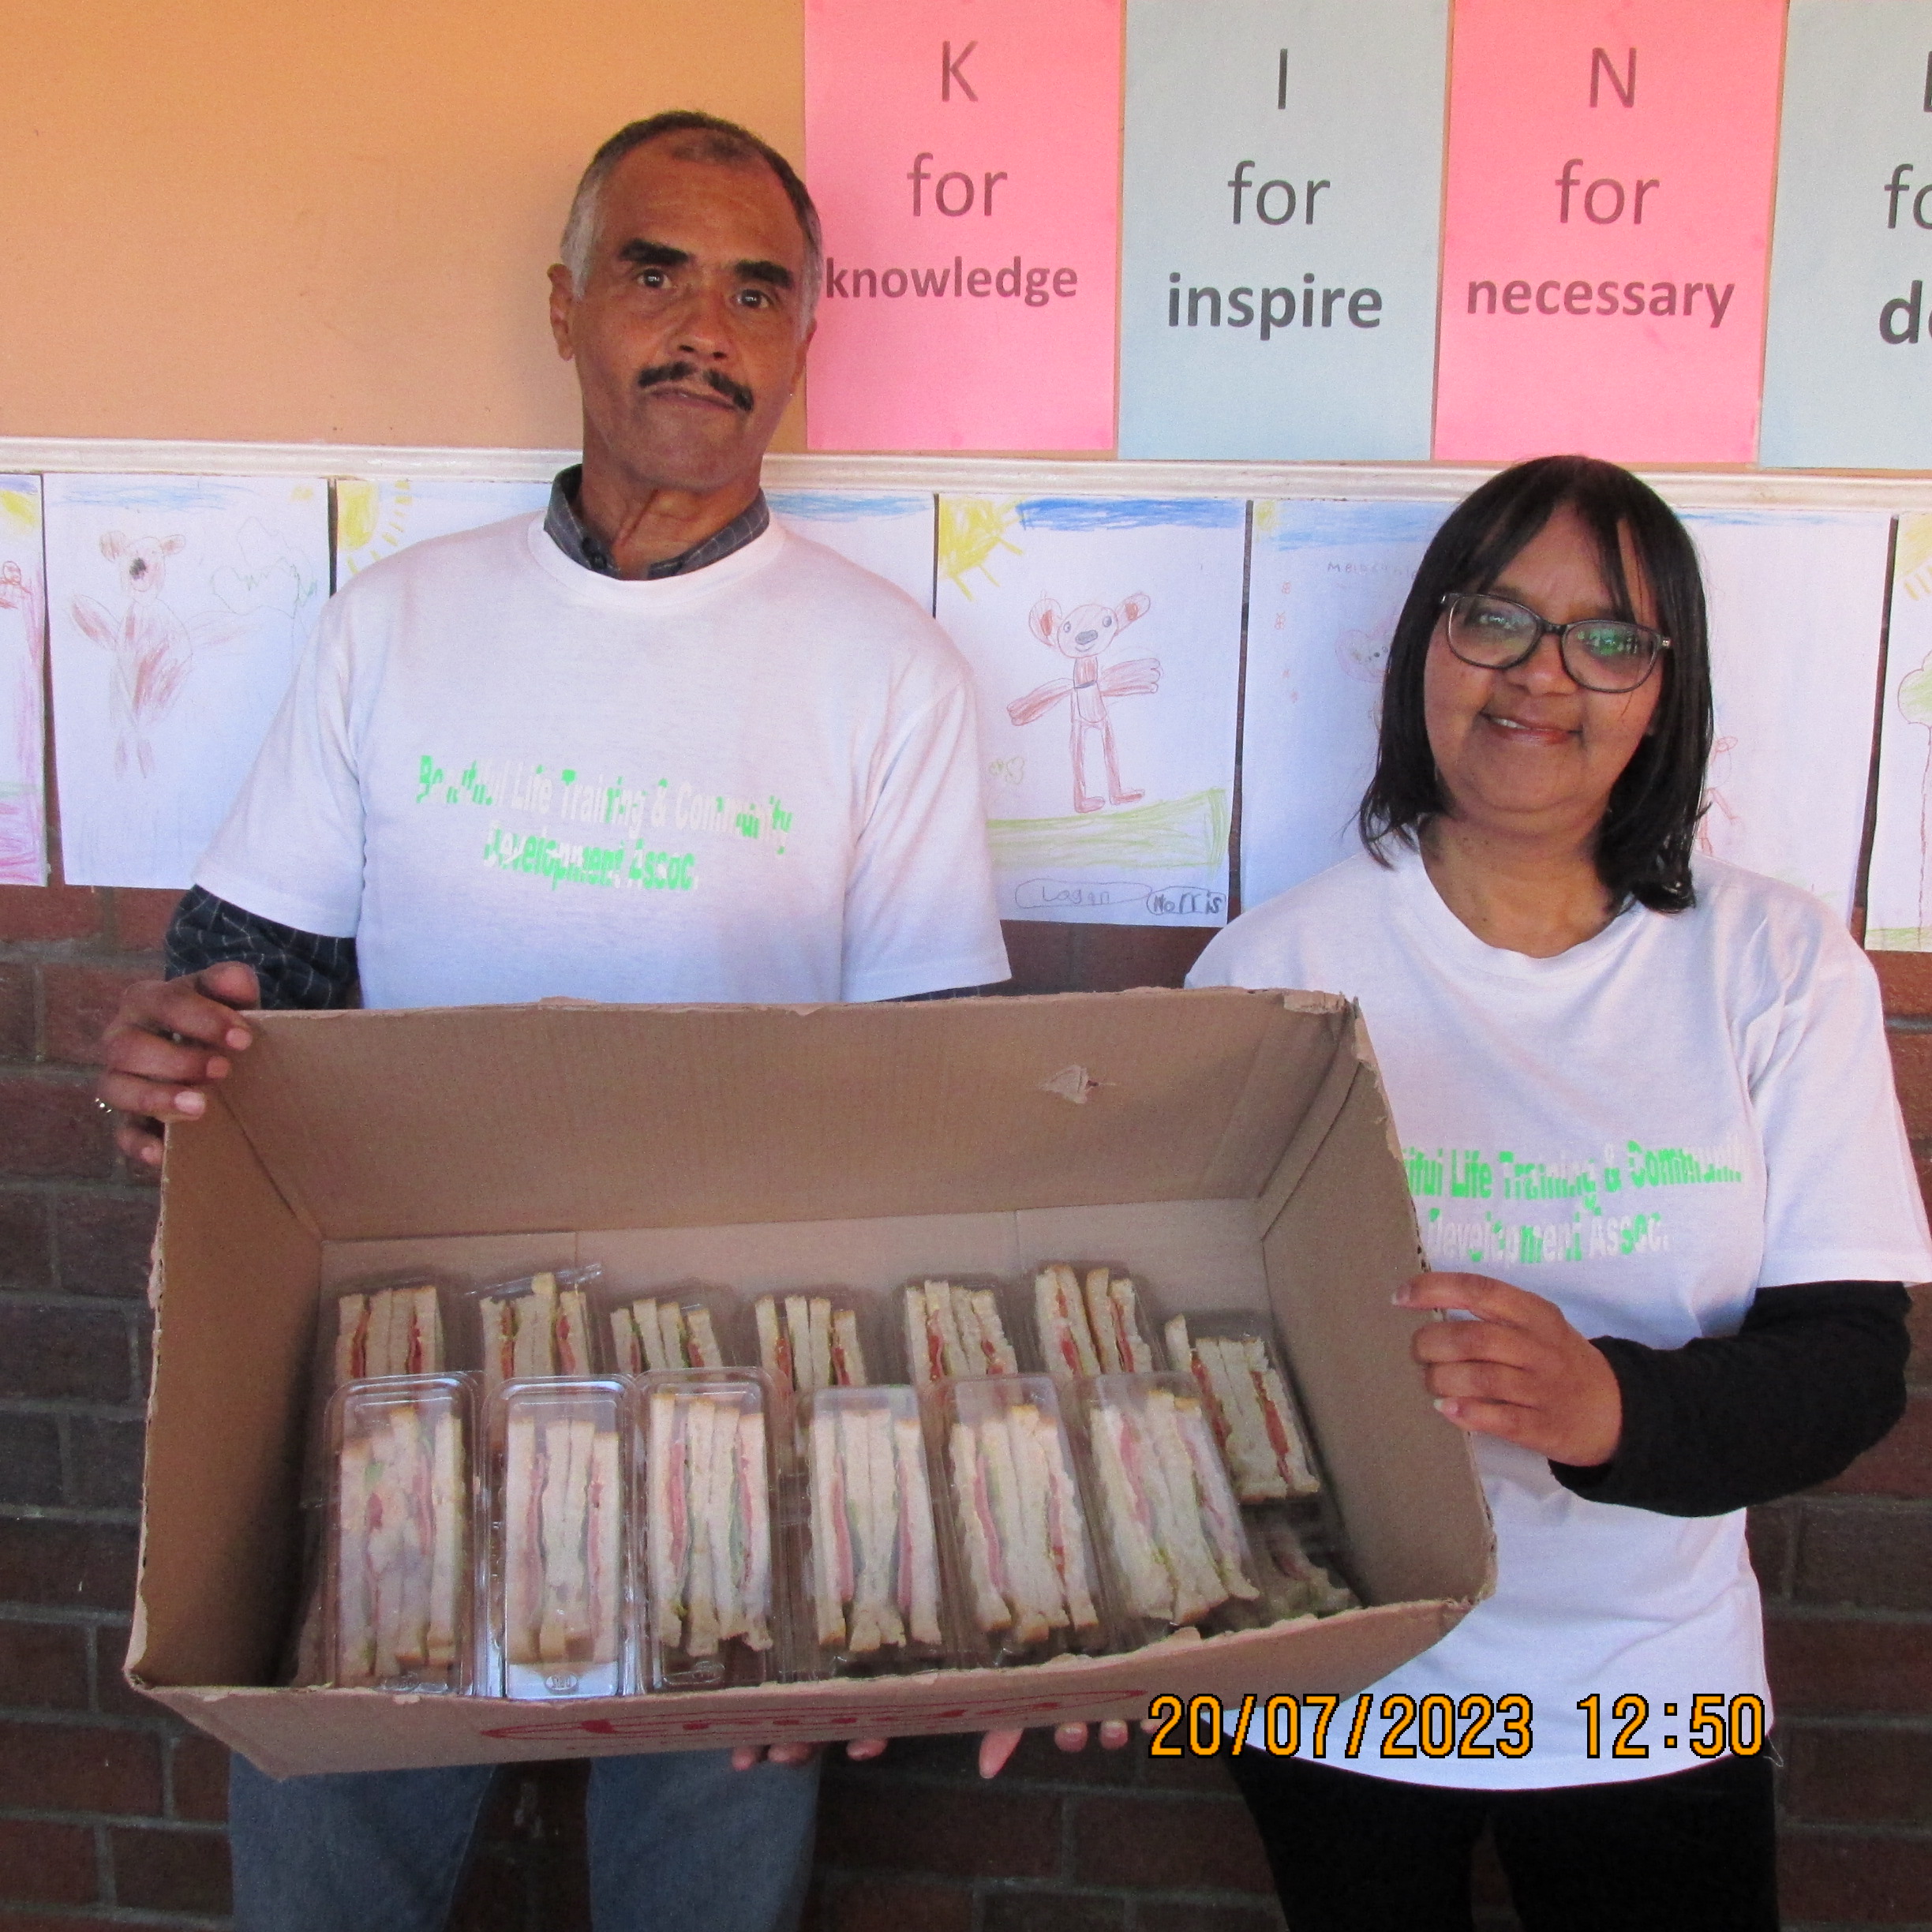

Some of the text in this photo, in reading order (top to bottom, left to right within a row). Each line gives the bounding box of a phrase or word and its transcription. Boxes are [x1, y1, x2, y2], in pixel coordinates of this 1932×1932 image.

[942, 40, 979, 102] K
[1278, 48, 1288, 110] I
[1589, 47, 1638, 108] N
[907, 152, 1008, 217] for
[1227, 159, 1331, 226] for
[1555, 158, 1661, 225] for
[825, 256, 1078, 307] knowledge
[1168, 271, 1383, 341] inspire
[1466, 279, 1735, 328] necessary
[1879, 279, 1932, 345] d
[1451, 1148, 1493, 1200] Life
